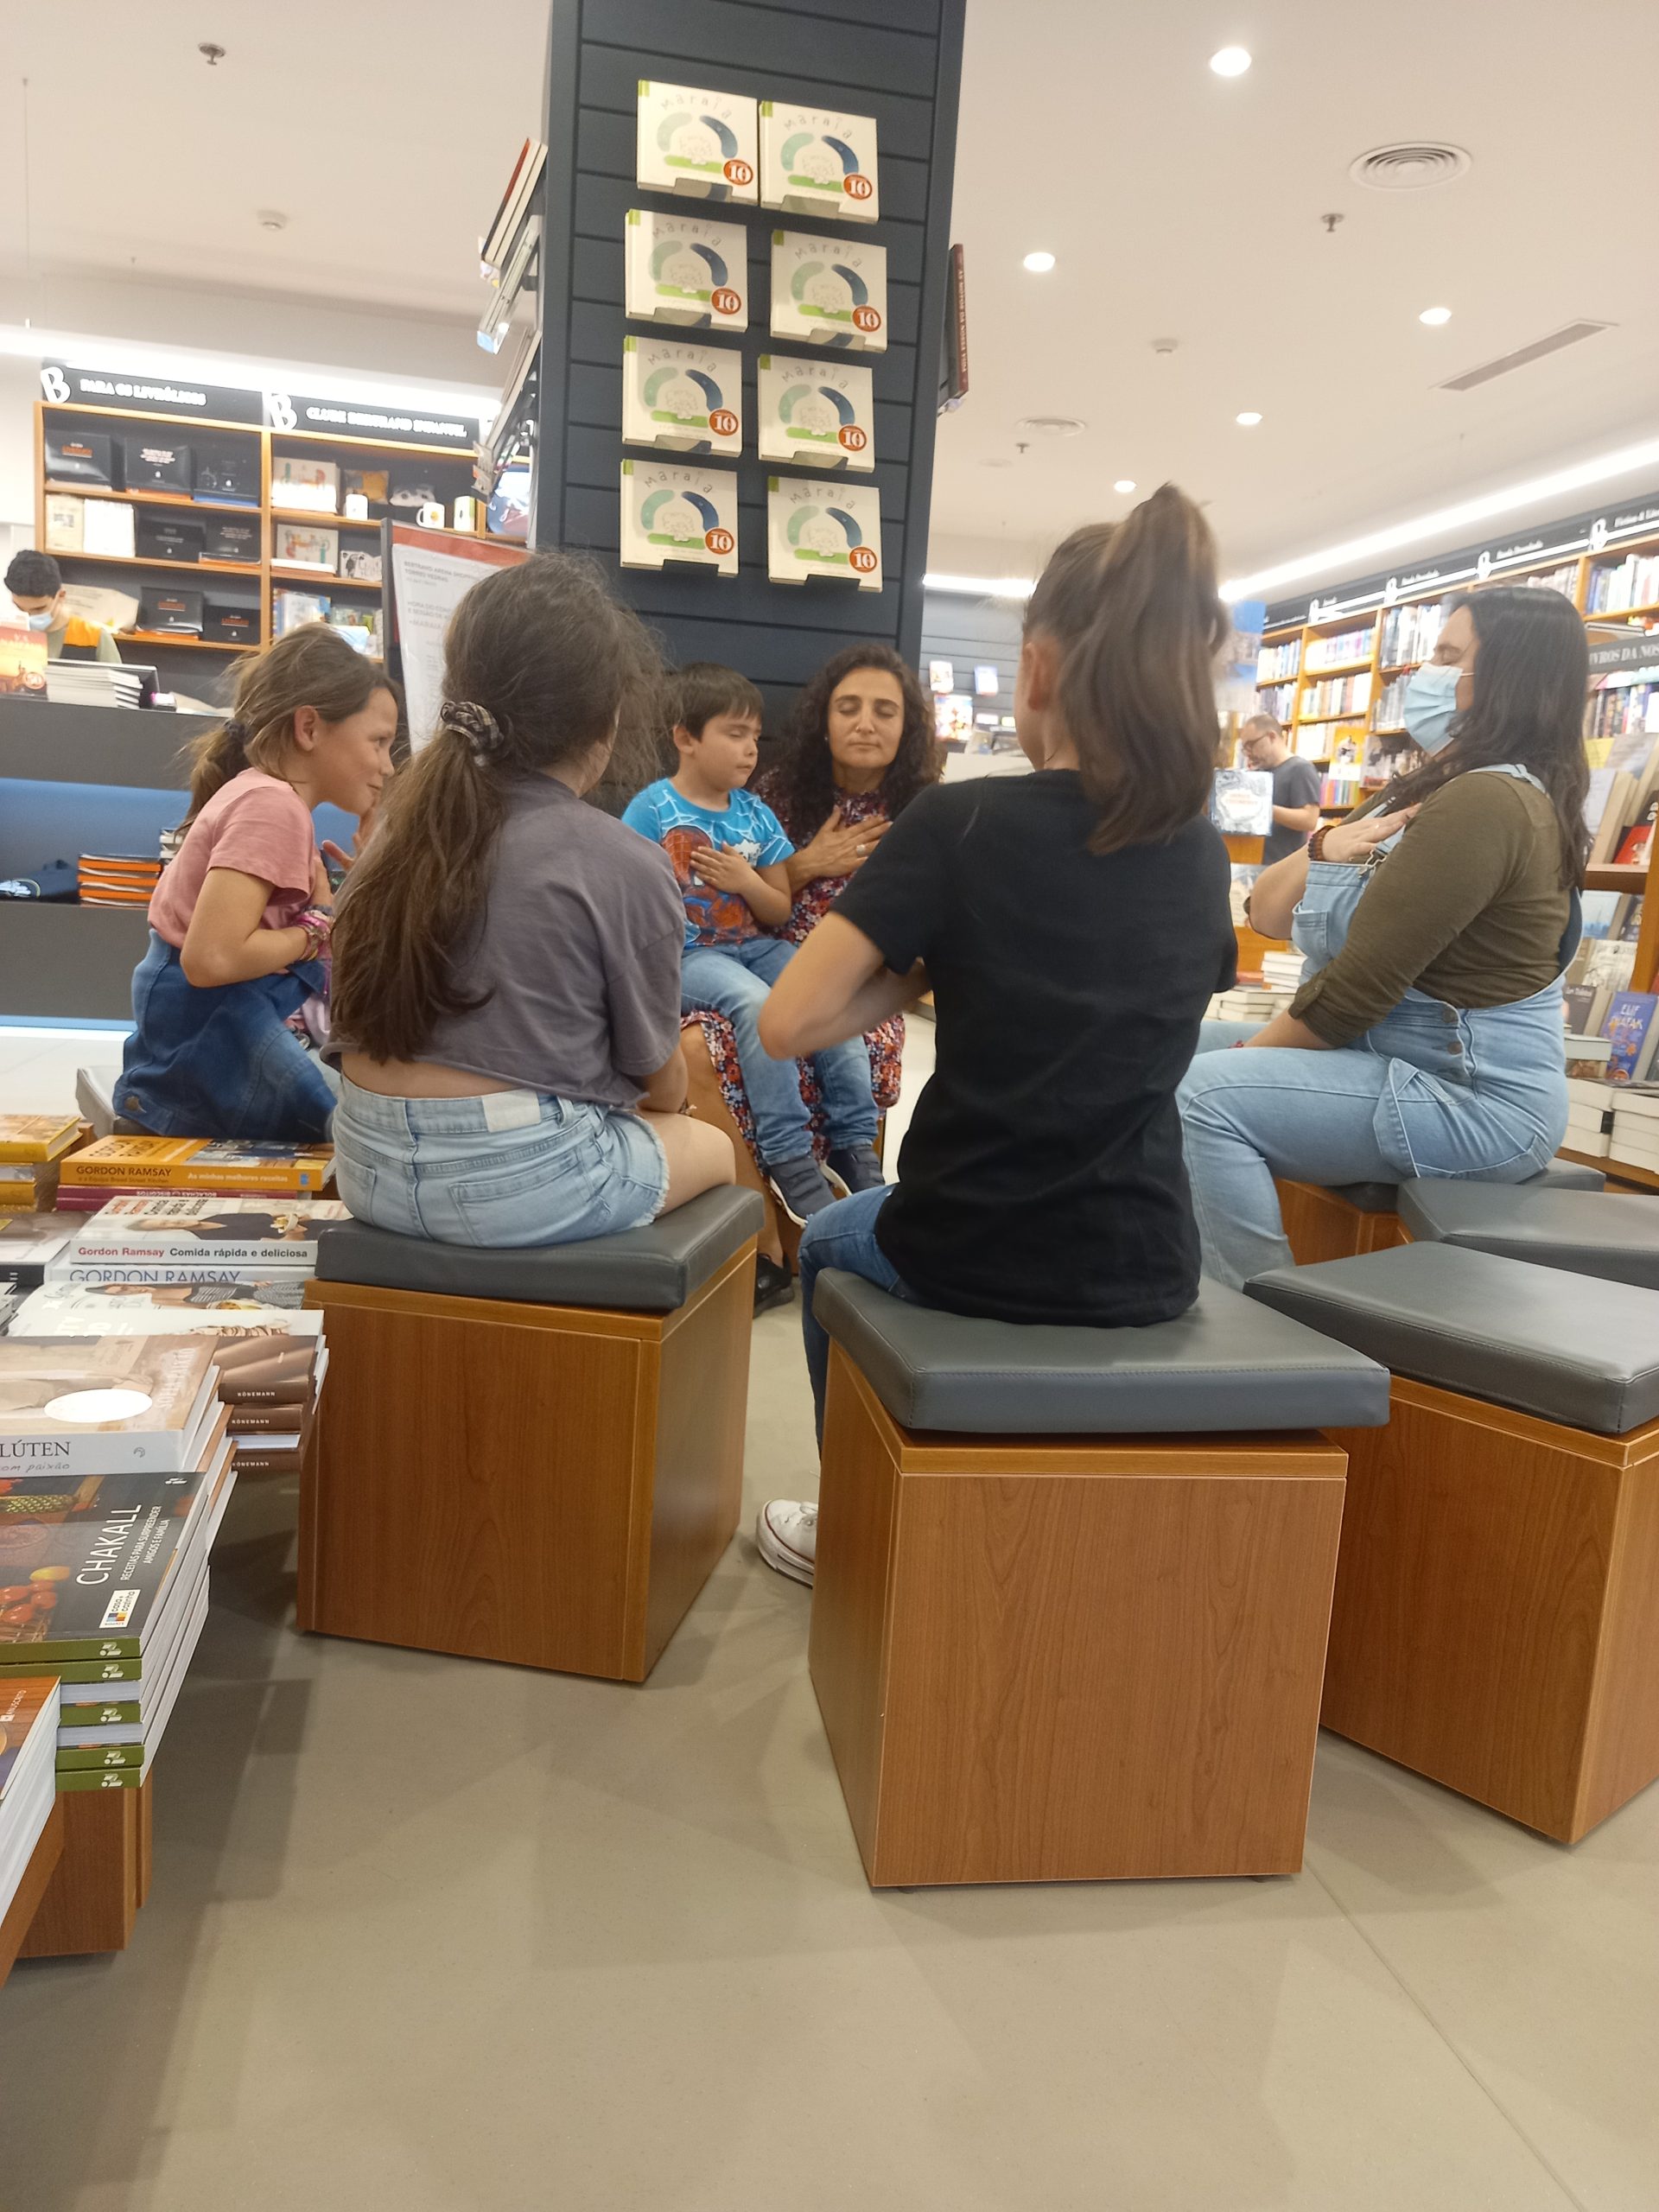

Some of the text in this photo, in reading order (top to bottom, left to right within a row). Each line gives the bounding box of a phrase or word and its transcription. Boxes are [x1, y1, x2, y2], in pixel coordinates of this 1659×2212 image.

[728, 164, 751, 182] 10
[849, 179, 870, 197] 10
[717, 293, 740, 312] 10
[859, 309, 880, 328] 10
[715, 415, 736, 433] 10
[844, 431, 866, 448] 10
[710, 532, 733, 551] 10
[855, 551, 875, 570] 10
[76, 1166, 172, 1177] GORDON RAMSAY
[78, 1247, 308, 1261] Gordon Ramsay Comida rápida e deliciosa
[70, 1269, 240, 1281] GORDON RAMSAY
[26, 1462, 70, 1473] paixão
[76, 1504, 142, 1585] CHAKALL
[143, 1543, 160, 1564] AMIGOS
[120, 1555, 140, 1580] RECEITAS
